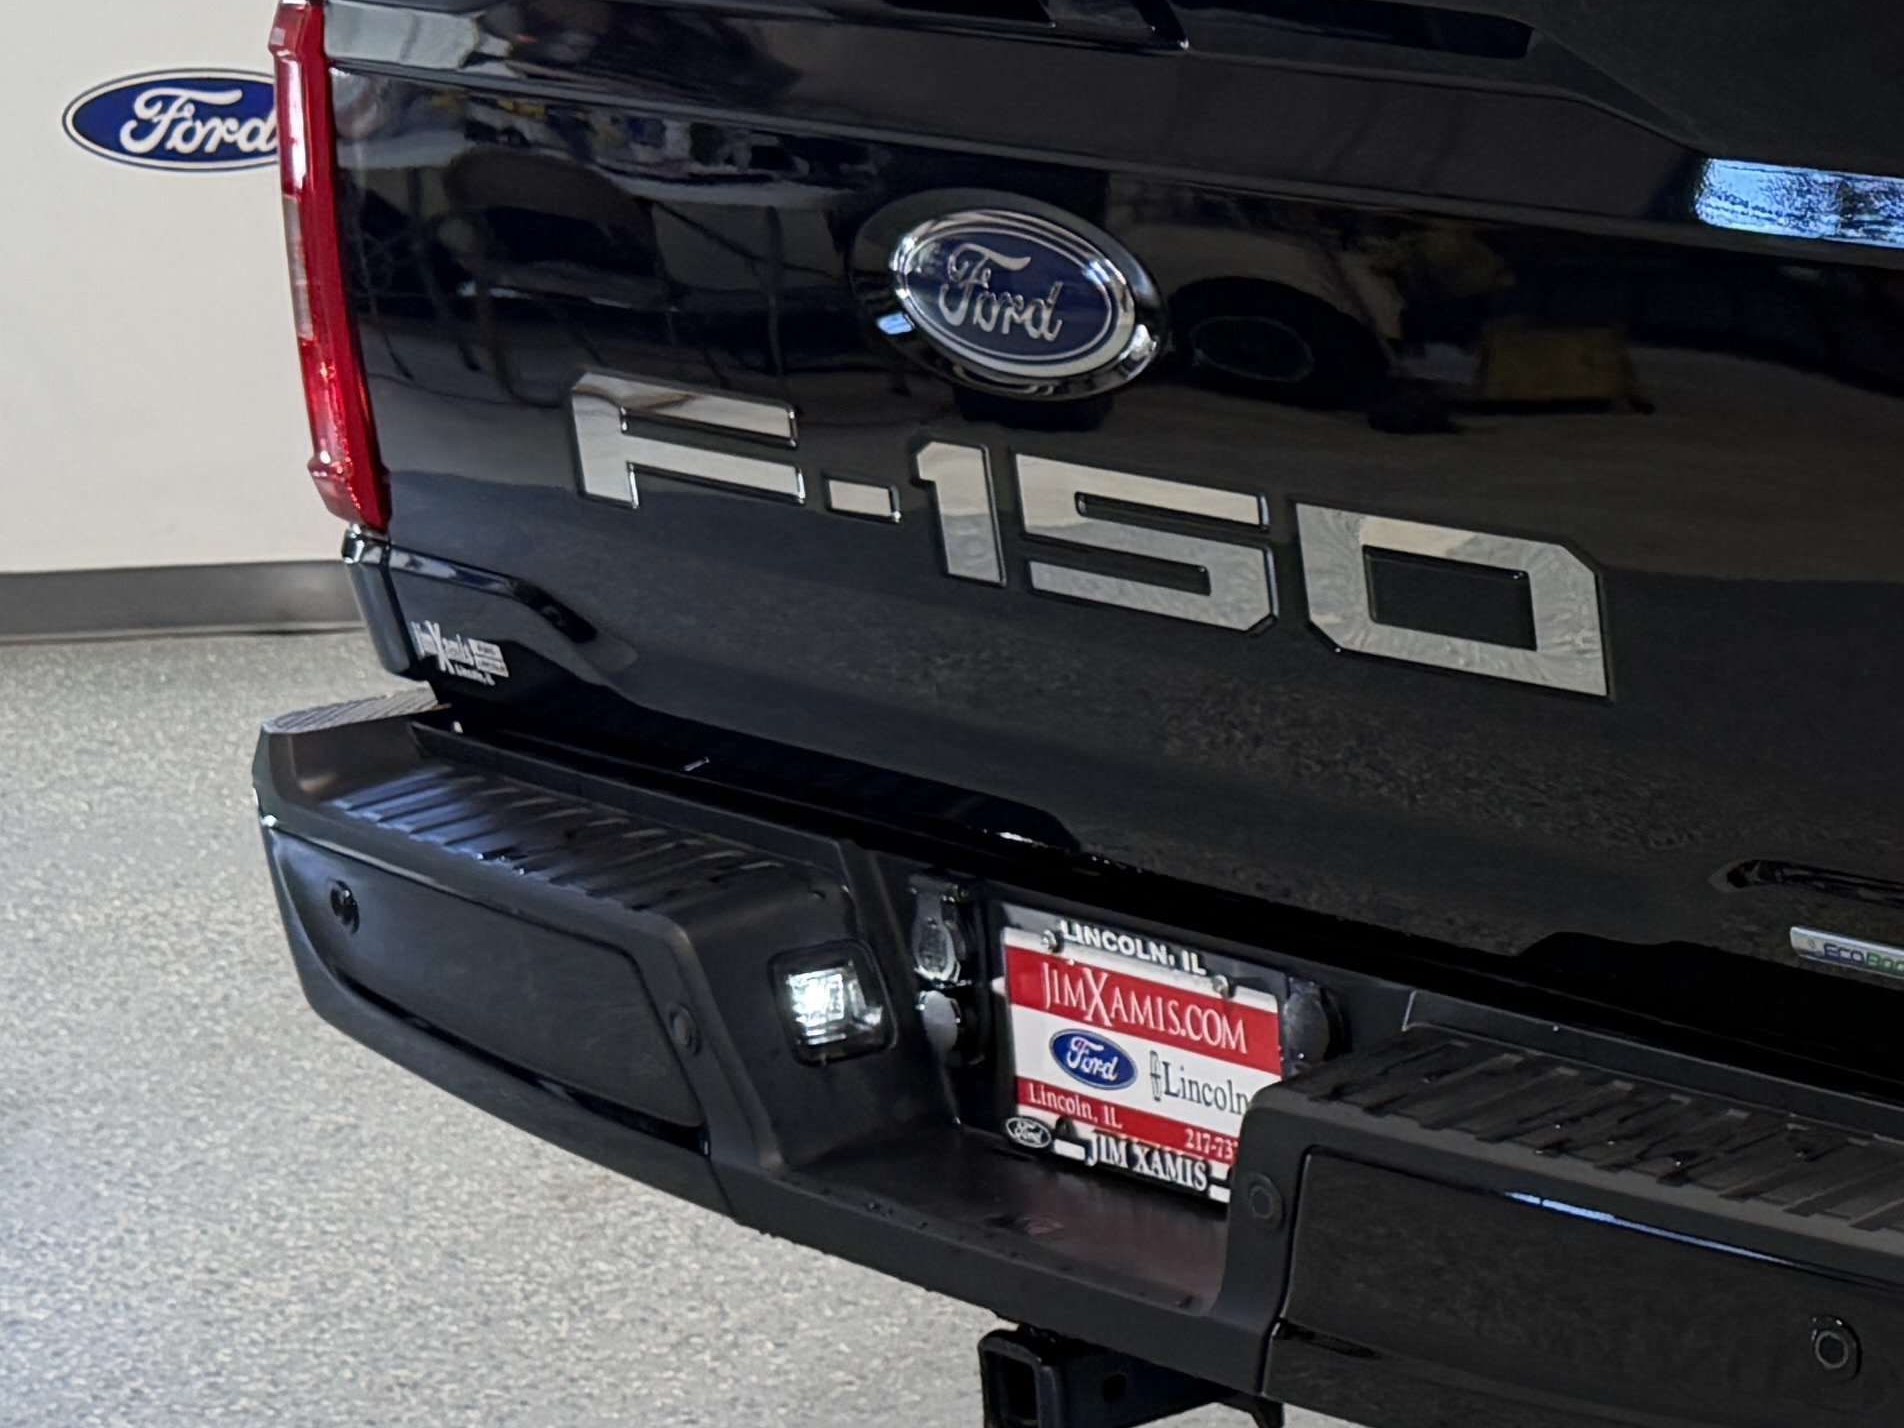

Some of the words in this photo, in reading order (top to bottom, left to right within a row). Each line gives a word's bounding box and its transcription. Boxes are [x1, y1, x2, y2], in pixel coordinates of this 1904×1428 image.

[937, 242, 1066, 342] Ford
[570, 370, 1614, 699] F-150
[1060, 919, 1177, 968] LINCOLN,
[1180, 949, 1208, 976] IL
[1040, 961, 1248, 1054] JIMXAMIS.COM
[1025, 1082, 1100, 1125] Lincoln,
[1103, 1107, 1123, 1130] IL
[1064, 1035, 1120, 1083] Ford
[1161, 1060, 1250, 1116] Lincoln
[1087, 1132, 1132, 1174] JIM
[1133, 1143, 1209, 1192] XAMIS
[1184, 1127, 1239, 1161] 217-73
